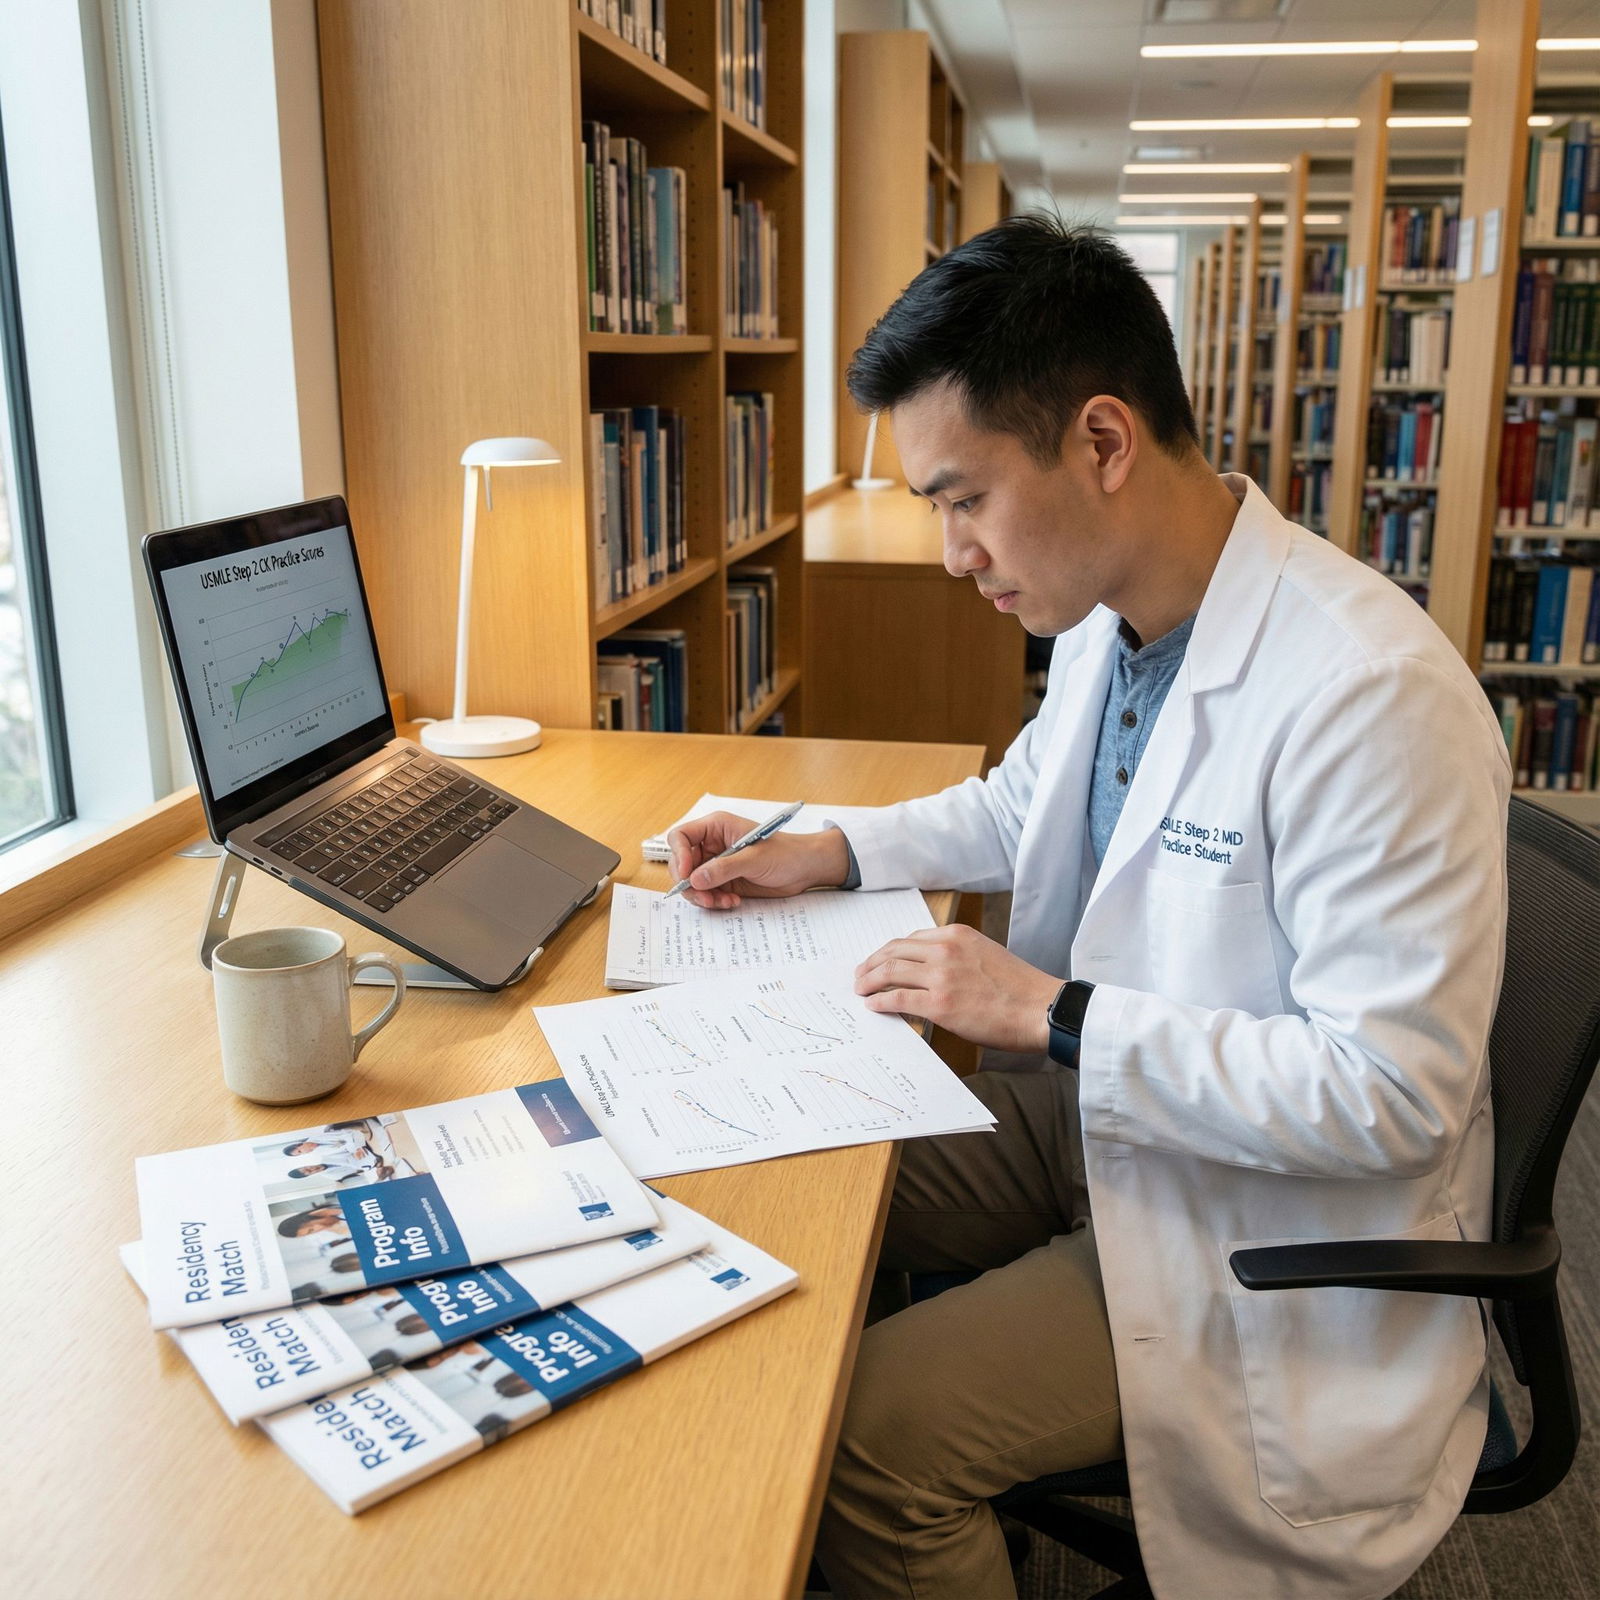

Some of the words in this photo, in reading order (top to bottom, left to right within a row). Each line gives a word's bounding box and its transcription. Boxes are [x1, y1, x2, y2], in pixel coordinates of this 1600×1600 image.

[200, 567, 231, 590] USMLE
[232, 565, 252, 582] Step
[252, 560, 259, 576] 2
[259, 558, 271, 573] CK
[1184, 822, 1210, 842] Step
[1213, 827, 1219, 842] 2
[1194, 844, 1232, 864] Student
[360, 1198, 400, 1269] Program
[400, 1226, 432, 1261] Info
[177, 1221, 212, 1304] Residency
[214, 1240, 249, 1297] Match
[415, 1279, 469, 1327] Progr
[456, 1280, 499, 1315] Info
[220, 1317, 285, 1390] Residen
[261, 1316, 322, 1378] Match
[547, 1330, 599, 1369] Info
[308, 1396, 392, 1470] Reside
[348, 1387, 427, 1452] Match
